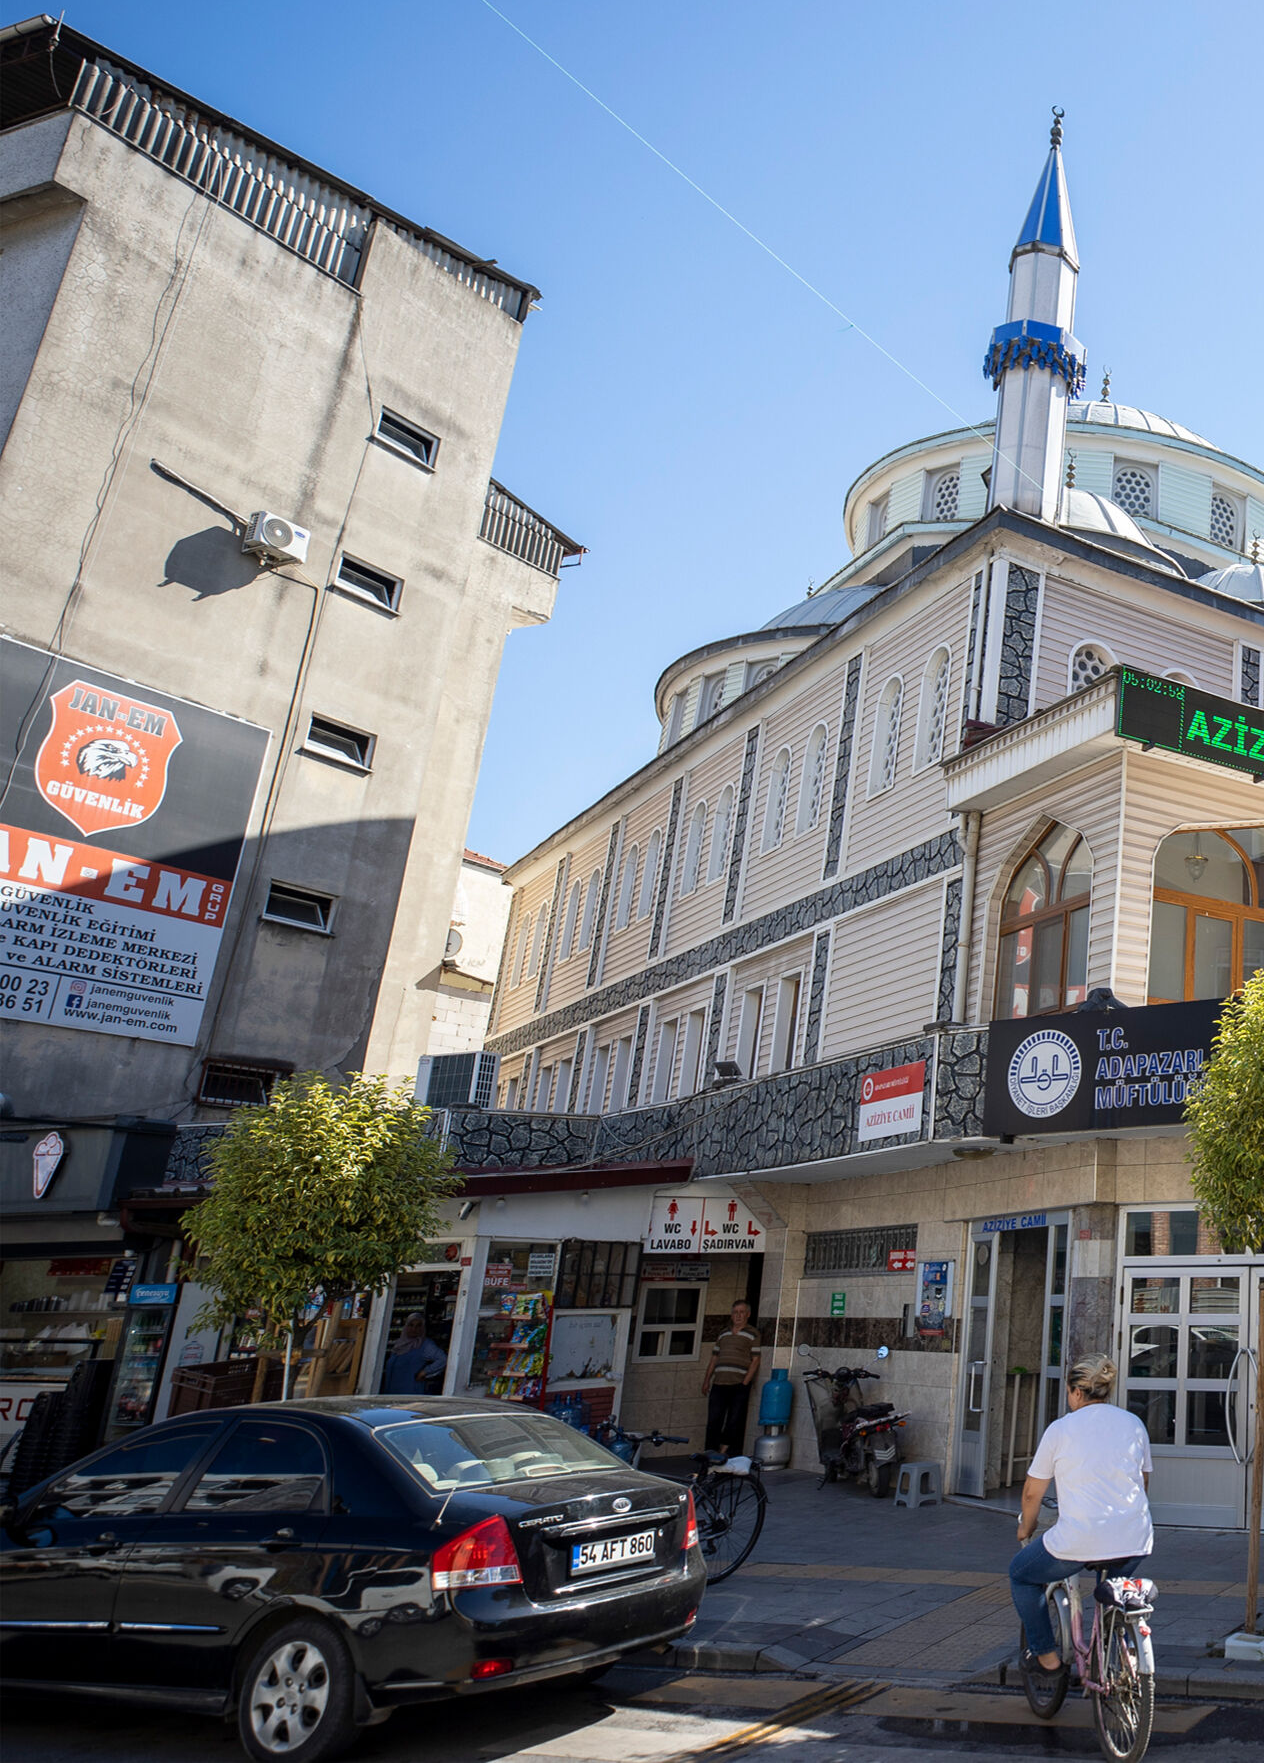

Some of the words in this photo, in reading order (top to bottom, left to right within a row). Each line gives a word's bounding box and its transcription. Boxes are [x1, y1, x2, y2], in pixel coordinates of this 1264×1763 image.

[68, 687, 168, 738] JAN-EM
[46, 779, 146, 819] GÜVENLİK
[0, 829, 207, 917] N-EM
[1, 885, 96, 915] GÜVENLİK
[1, 898, 82, 927] ÜVENLİK
[87, 918, 157, 943] EĞİTİMİ
[12, 935, 58, 953] KAPI
[62, 943, 199, 980] DEDEKTÖRLERİ
[49, 922, 119, 949] İZLEME
[121, 939, 200, 966] MERKEZİ
[6, 950, 27, 963] ve
[31, 955, 97, 976] ALARM
[100, 965, 205, 996] SİSTEMLERİ
[26, 978, 50, 997] 23
[90, 983, 176, 1008] janemguvenlik
[21, 997, 44, 1014] 51
[85, 997, 172, 1021] janemguvenlik
[63, 1007, 178, 1034] www.jan-em.com
[1096, 1026, 1129, 1052] T.C.
[1095, 1048, 1205, 1081] ADAPAZARI
[664, 1223, 682, 1234] WC
[722, 1223, 740, 1234] WC
[650, 1238, 692, 1250] LAVABO
[702, 1238, 755, 1252] ŞADIRVAN
[580, 1547, 597, 1565] 54
[601, 1538, 628, 1560] AFT
[630, 1534, 654, 1555] 860
